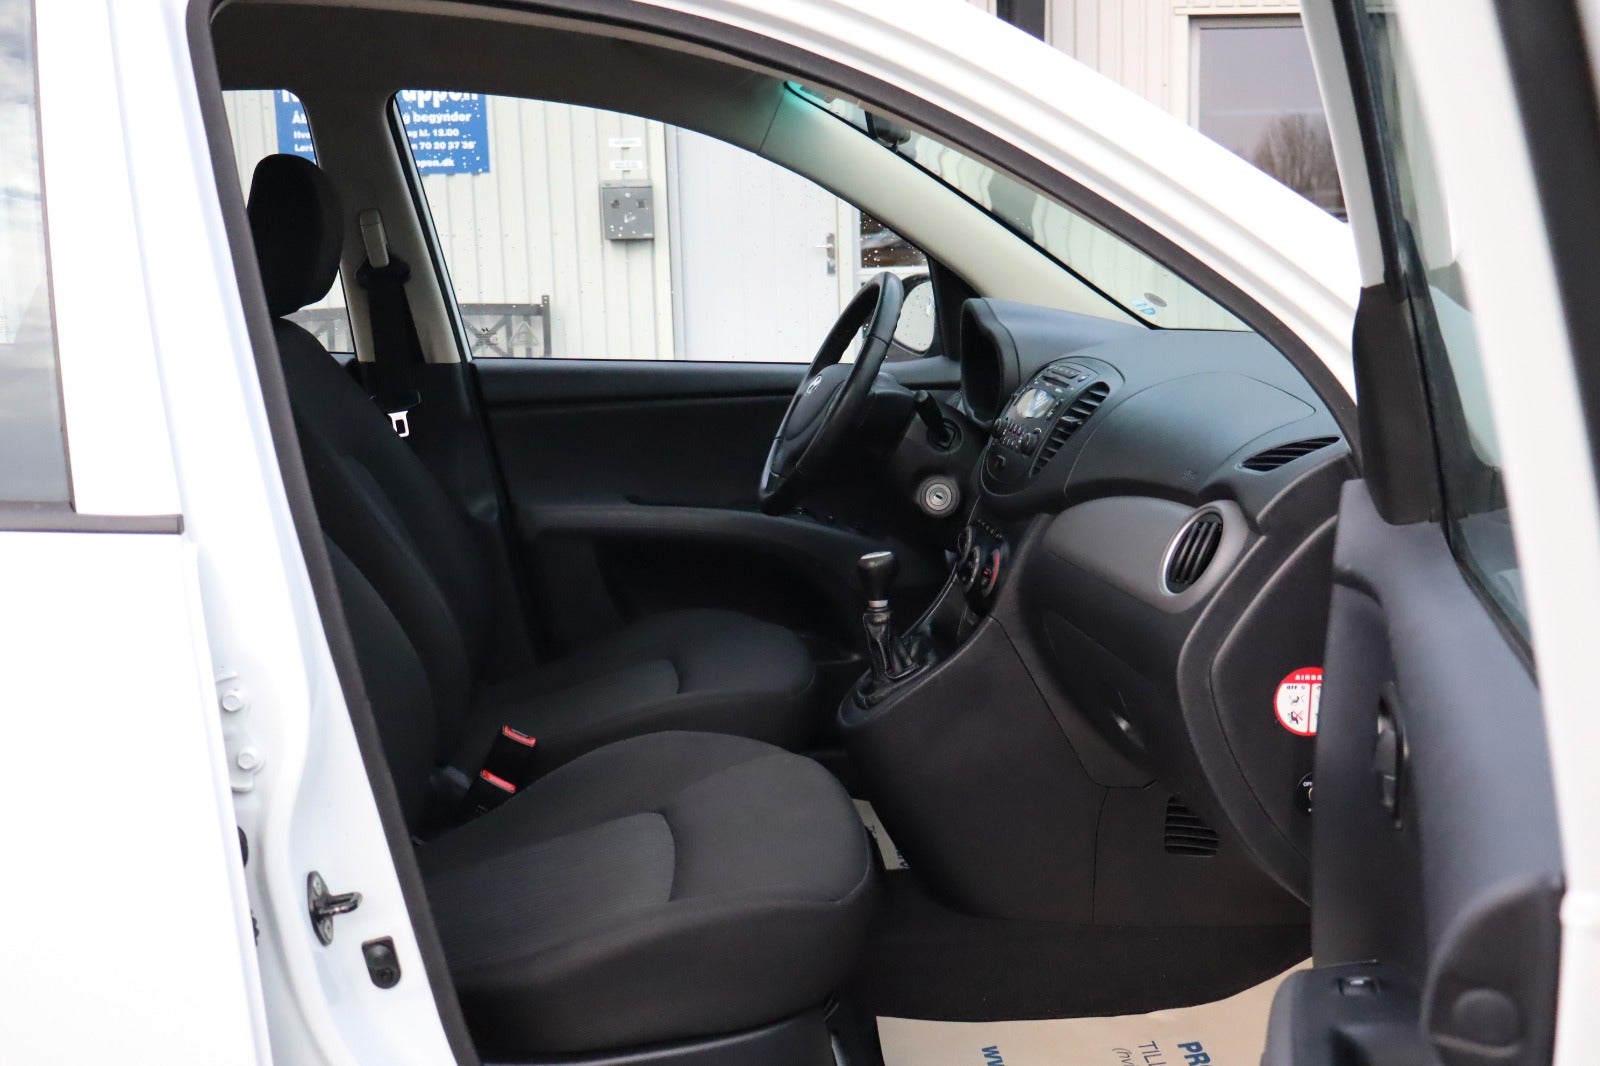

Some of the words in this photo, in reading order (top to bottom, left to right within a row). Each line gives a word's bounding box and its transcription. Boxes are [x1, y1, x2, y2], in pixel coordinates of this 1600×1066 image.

[412, 111, 471, 124] begynder
[432, 127, 460, 137] 12.00
[419, 141, 432, 150] 70
[433, 141, 446, 150] 20
